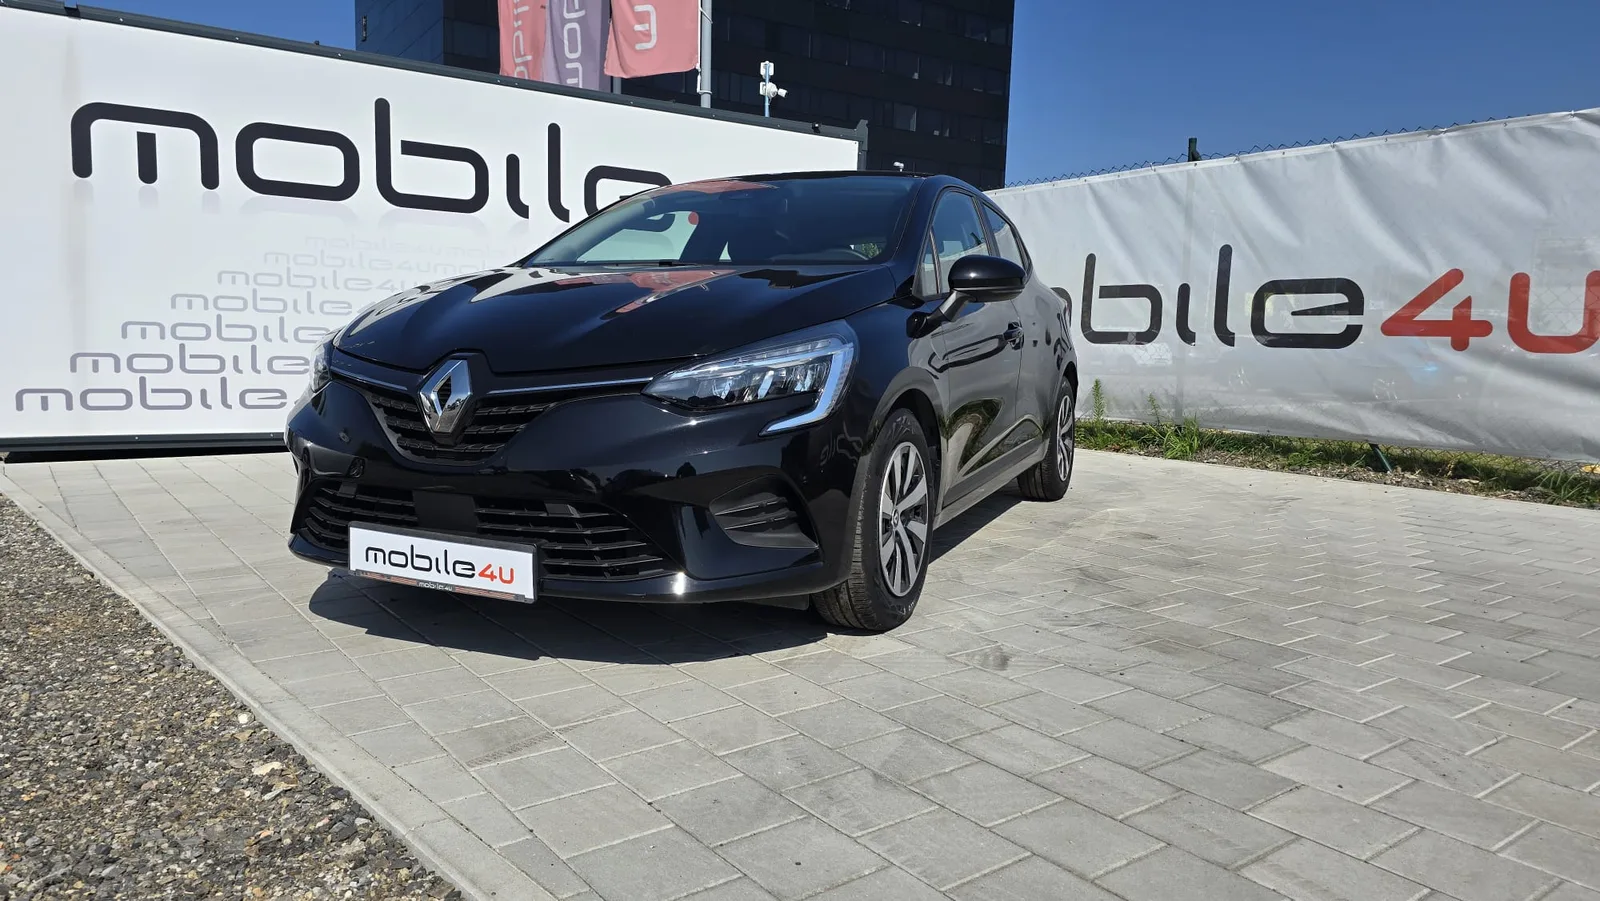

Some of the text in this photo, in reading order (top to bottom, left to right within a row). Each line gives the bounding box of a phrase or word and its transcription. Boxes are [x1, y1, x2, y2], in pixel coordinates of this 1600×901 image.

[70, 97, 699, 233] mobile
[170, 287, 376, 316] mobile
[70, 342, 310, 375] mobile
[15, 376, 299, 411] mobile
